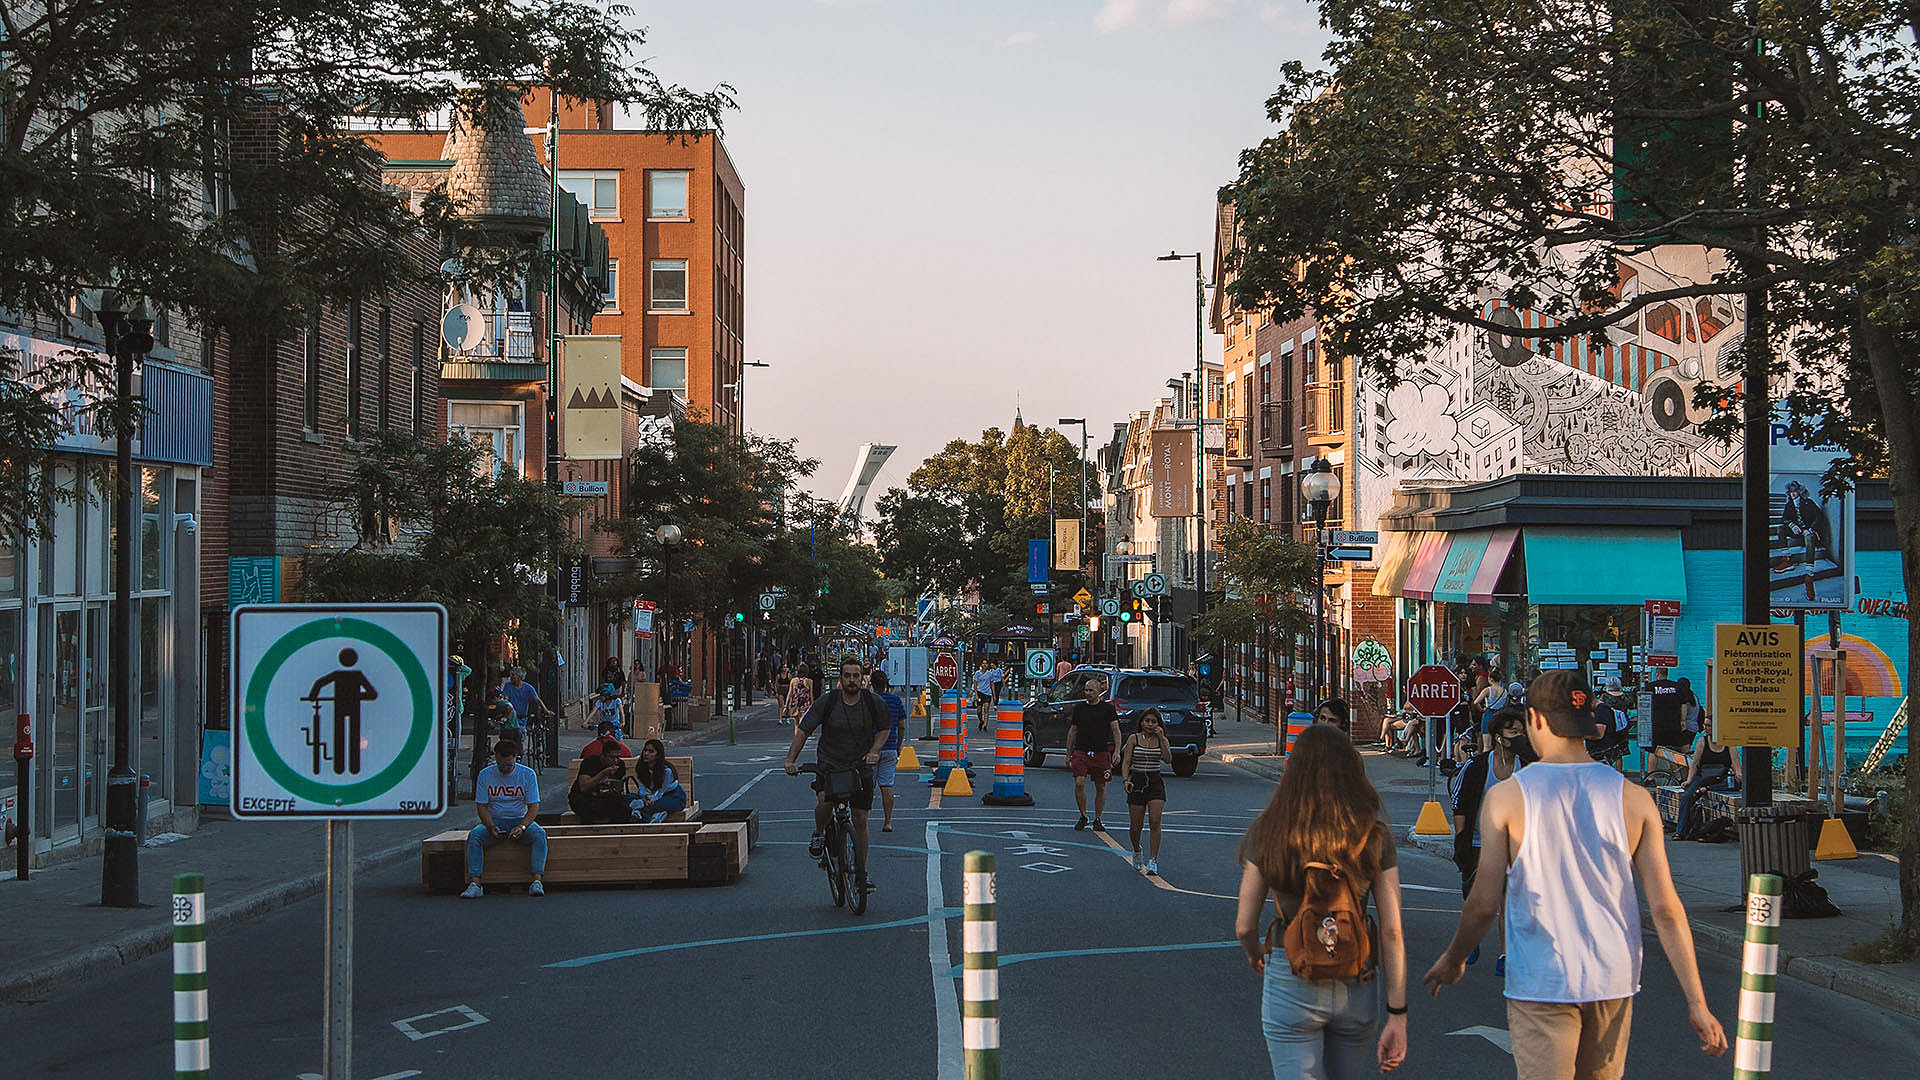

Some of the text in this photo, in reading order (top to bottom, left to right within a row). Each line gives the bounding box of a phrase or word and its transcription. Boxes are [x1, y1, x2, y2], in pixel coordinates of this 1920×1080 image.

[570, 566, 581, 603] bubbles
[1858, 597, 1891, 616] OVER
[1736, 631, 1779, 646] AVIS
[1724, 650, 1791, 658] Piétonnisation
[936, 665, 956, 677] ARRÊT
[1722, 667, 1793, 677] du Mont-Royal,
[1755, 676, 1775, 684] Parc
[1410, 681, 1457, 698] ARRÊT
[1735, 685, 1780, 694] Chapleau
[488, 785, 524, 797] NASA
[243, 797, 431, 811] EXCEPTÉ SPVM
